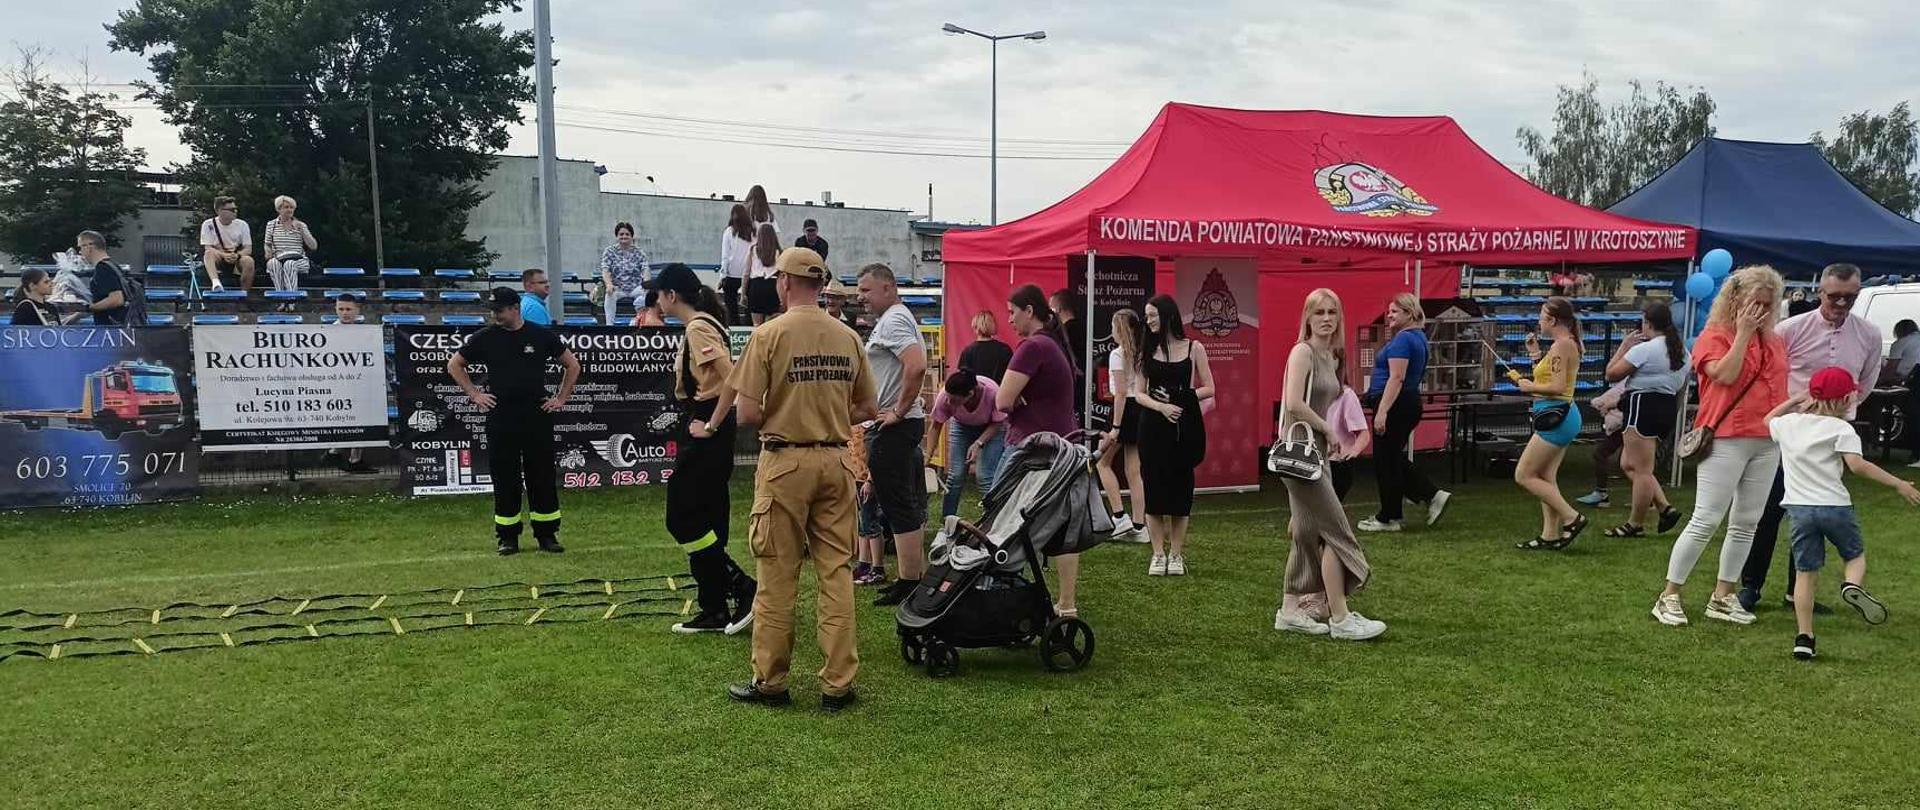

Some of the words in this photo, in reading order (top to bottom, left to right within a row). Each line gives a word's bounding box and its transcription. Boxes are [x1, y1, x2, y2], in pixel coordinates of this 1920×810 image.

[1100, 216, 1193, 242] KOMENDA
[1197, 221, 1302, 245] POWIATOWA
[1307, 225, 1422, 251] PAŃSTWOWEJ
[1427, 227, 1487, 252] STRAŻY
[1492, 227, 1569, 250] POŻARNEJ
[1574, 230, 1587, 249] W
[1591, 229, 1686, 249] KROTOSZYNIE
[1085, 270, 1139, 282] chotnicza
[1106, 285, 1145, 297] Pożarna
[3, 328, 137, 349] SROCZAN
[252, 331, 328, 349] BIURO
[205, 350, 376, 369] RACHUNKOWE
[599, 351, 679, 361] DOSTAWCZYC
[793, 355, 850, 368] PAŃSTWOWA
[416, 366, 444, 374] oraz
[787, 370, 814, 383] STRAŻ
[255, 387, 294, 398] Lucyna
[298, 386, 332, 396] Piasna
[236, 400, 259, 413] tel.
[264, 400, 291, 412] 510
[297, 400, 321, 412] 183
[327, 399, 353, 411] 603
[411, 440, 471, 450] KOBYLIN
[16, 456, 67, 479] 603
[82, 453, 131, 477] 775
[144, 452, 185, 475] 071
[563, 472, 601, 488] 512
[611, 470, 650, 486] 132
[99, 492, 143, 504] KOBYLIN
